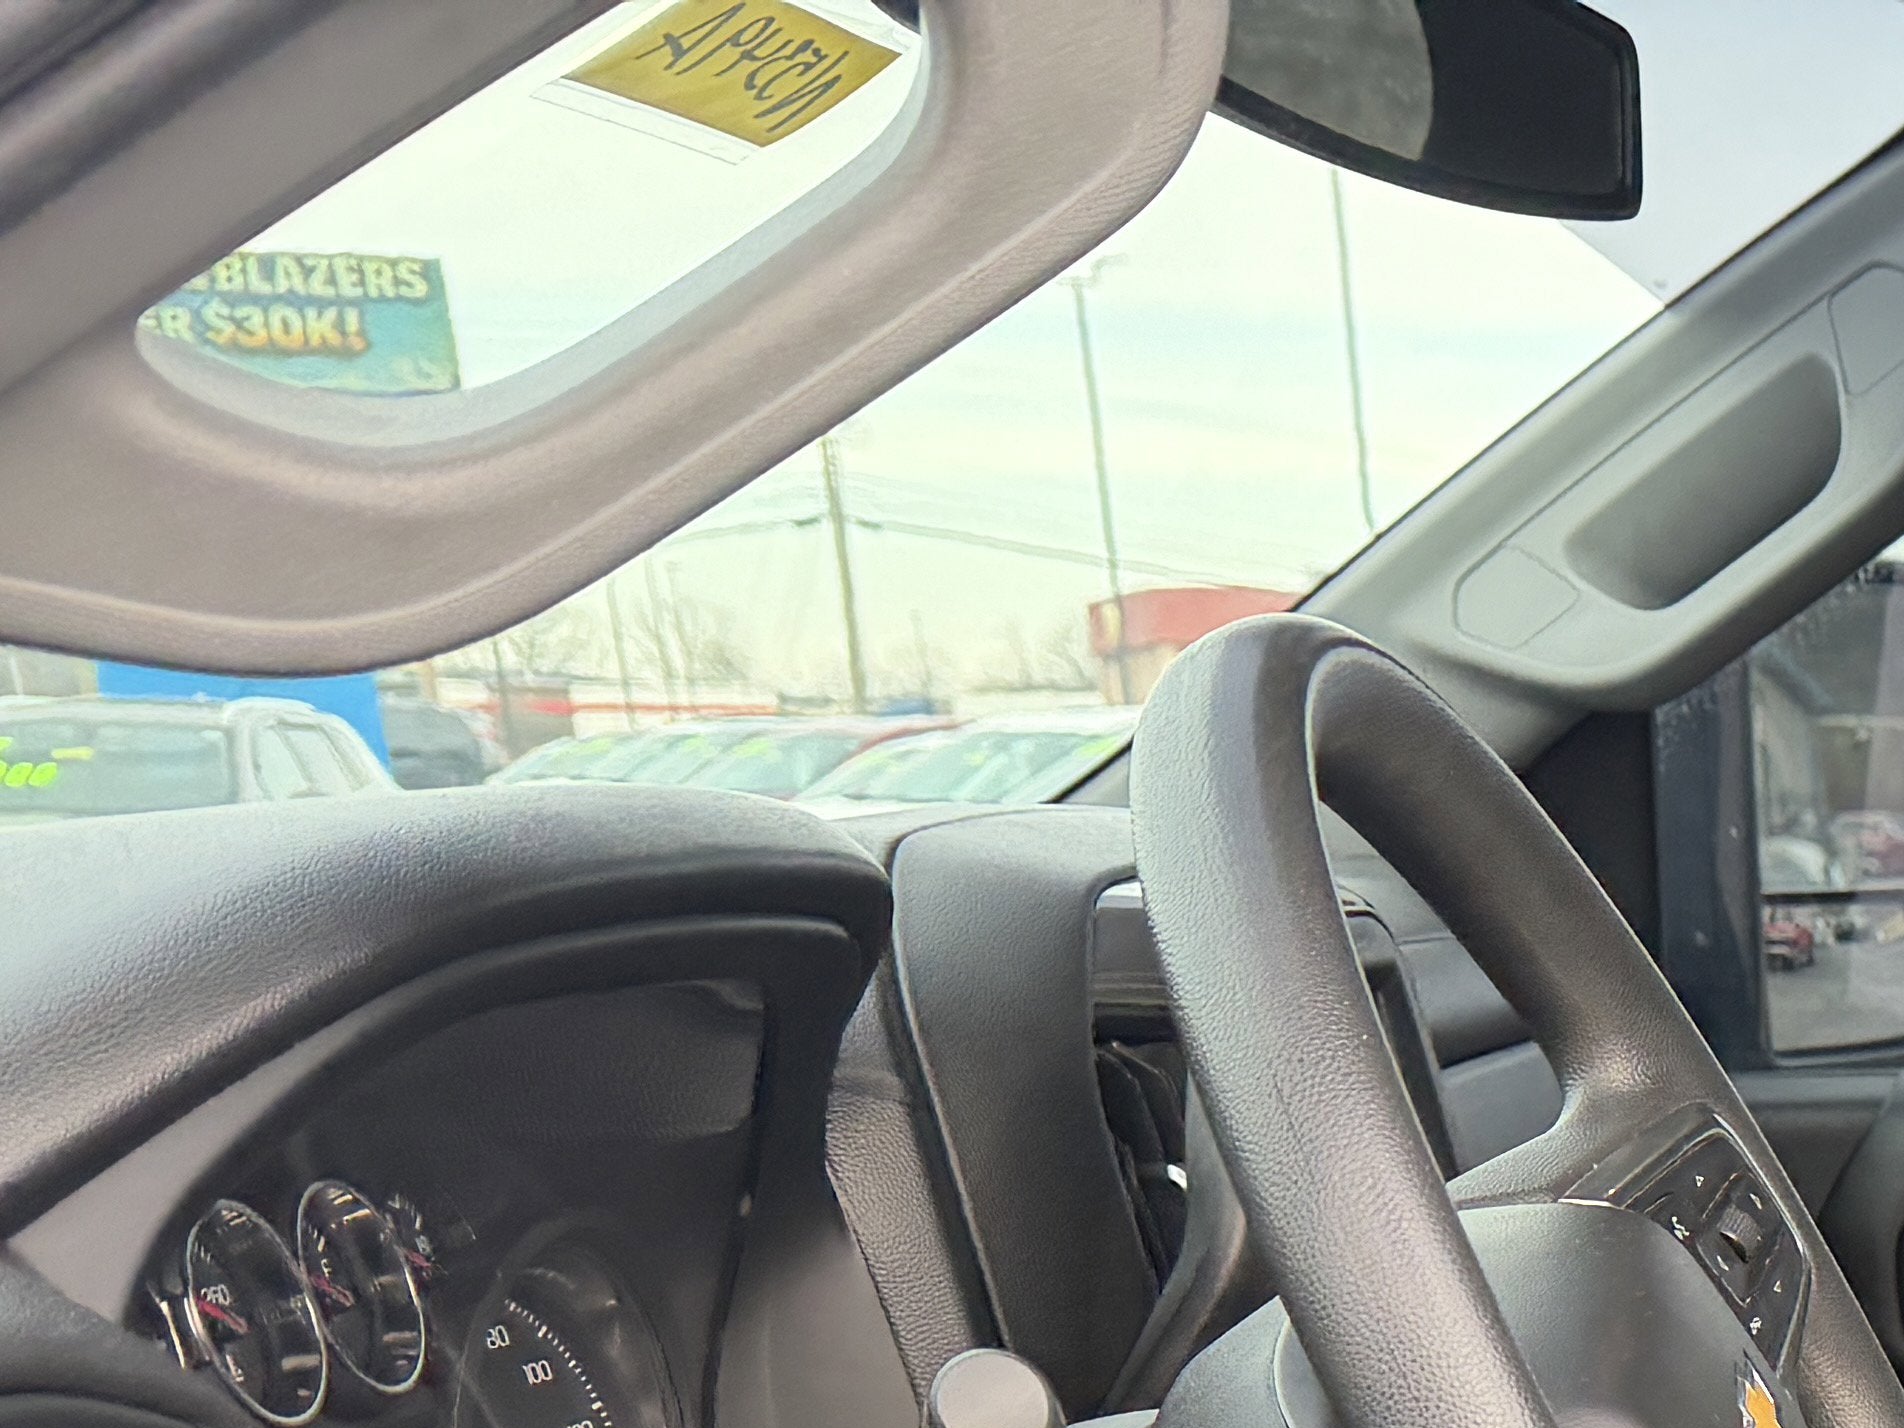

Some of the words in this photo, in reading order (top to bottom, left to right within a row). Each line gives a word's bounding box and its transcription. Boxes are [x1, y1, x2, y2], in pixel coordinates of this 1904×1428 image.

[211, 254, 428, 298] BLAZERS
[201, 302, 369, 352] $30K!
[486, 1324, 510, 1349] 80
[522, 1359, 553, 1385] 100
